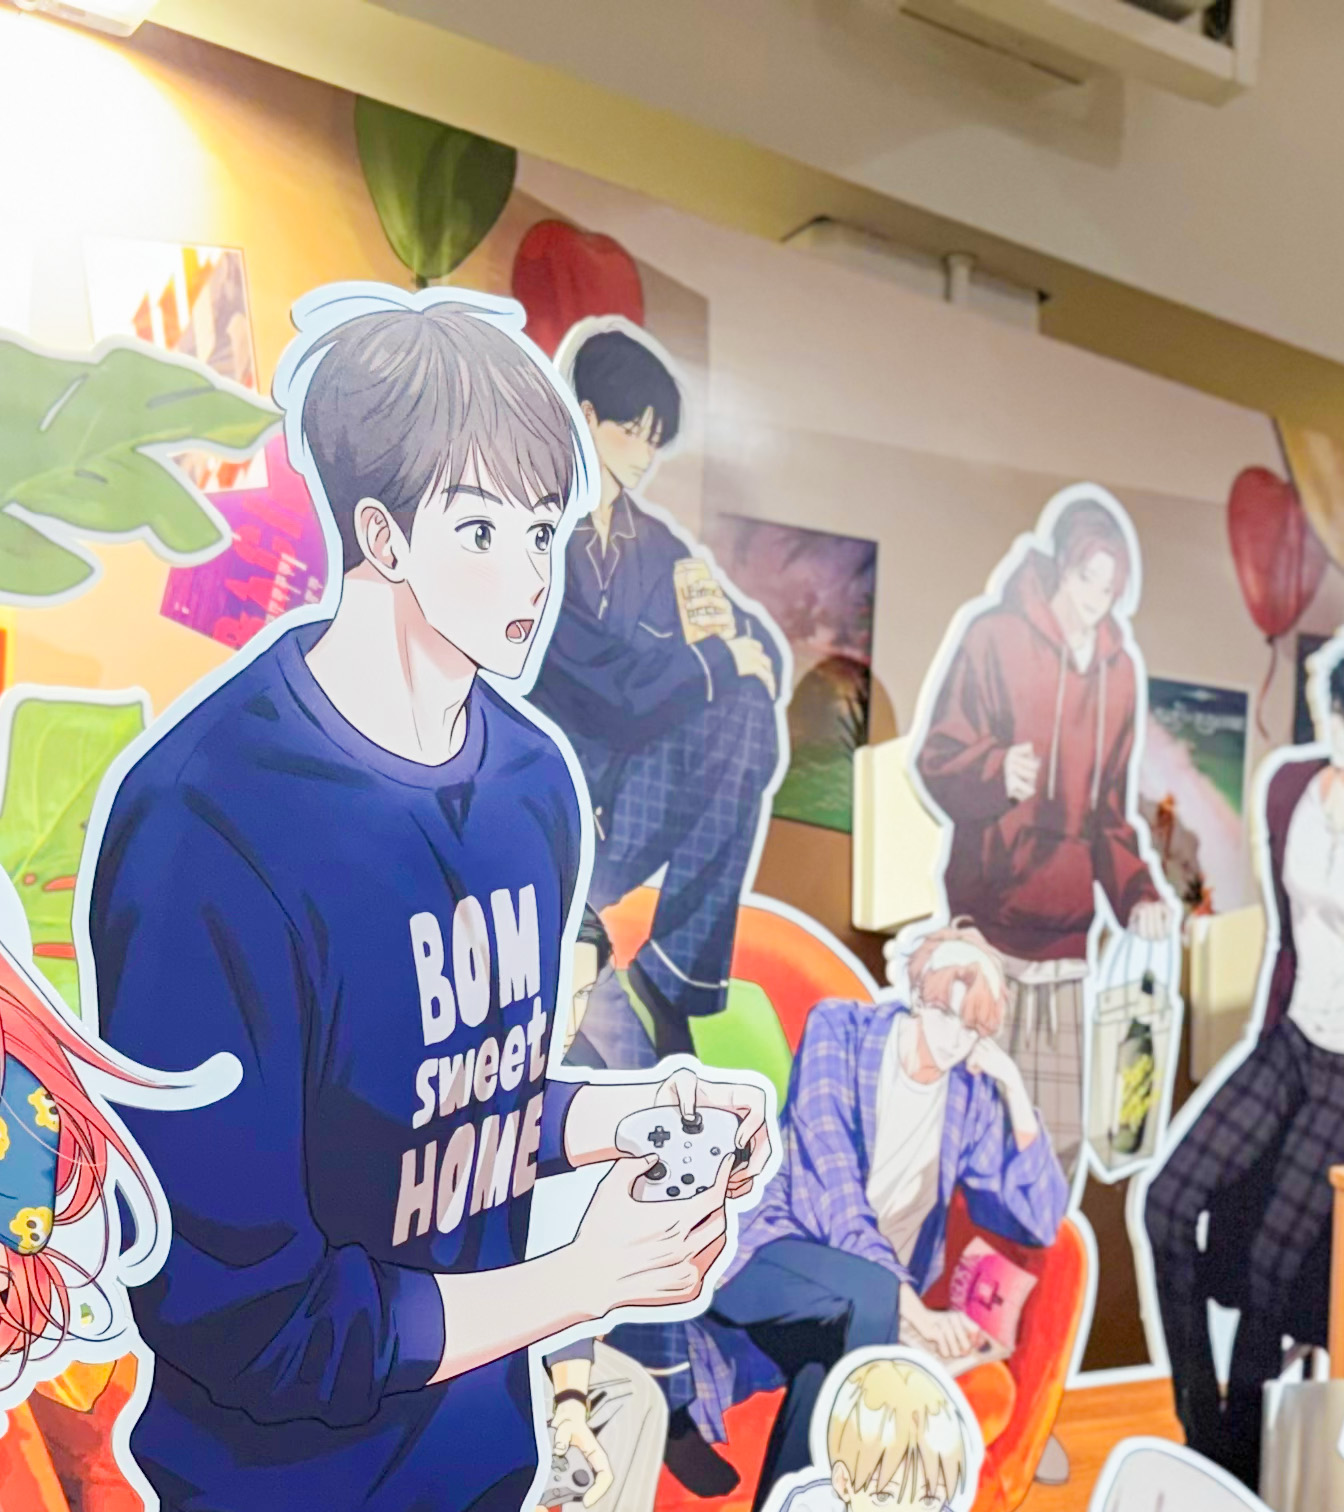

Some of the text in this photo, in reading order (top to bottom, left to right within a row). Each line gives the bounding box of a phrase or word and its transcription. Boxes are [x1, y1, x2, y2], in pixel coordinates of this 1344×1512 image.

[409, 883, 541, 1046] BOM
[412, 997, 546, 1130] sweet
[392, 1091, 543, 1247] HOME
